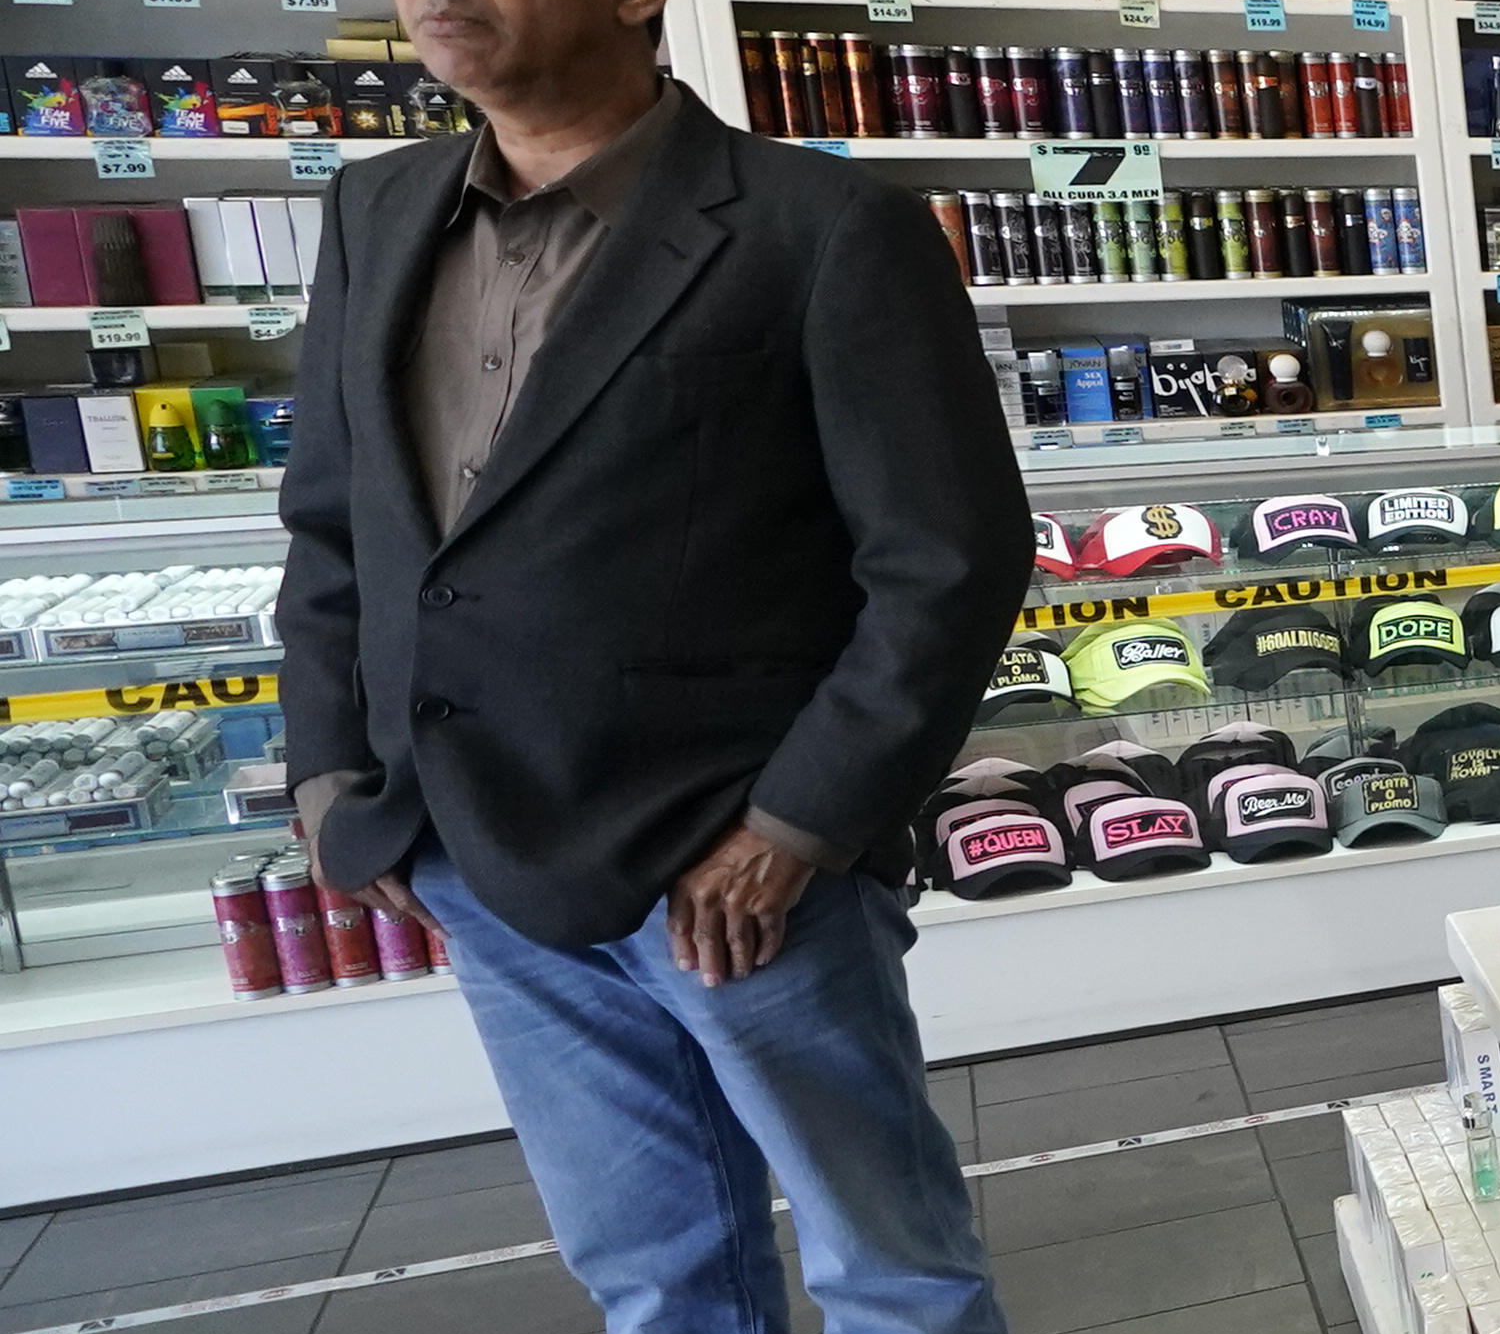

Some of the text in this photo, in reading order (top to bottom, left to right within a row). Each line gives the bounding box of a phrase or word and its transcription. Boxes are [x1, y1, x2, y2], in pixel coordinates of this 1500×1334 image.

[870, 7, 908, 19] $14.99
[37, 107, 71, 122] TEAM
[175, 109, 208, 123] TEAM
[40, 116, 69, 131] FIVE
[175, 118, 205, 132] FIVE
[102, 162, 147, 175] $7.99
[295, 164, 337, 176] $6.99
[1052, 146, 1126, 185] 7
[1042, 188, 1160, 201] ALL CUBA 3.4 MEN
[97, 331, 142, 345] $19.99
[1384, 496, 1448, 511] LIMITED
[1273, 509, 1338, 531] CRAY
[1384, 508, 1448, 523] EDITION
[1214, 568, 1448, 608] CAUTION
[1021, 596, 1150, 629] TION
[1380, 619, 1452, 642] DOPE
[1120, 641, 1185, 664] Baller
[997, 673, 1041, 685] PLOMO
[1371, 777, 1409, 790] PLATA
[1369, 798, 1412, 811] PLOMO
[1105, 814, 1188, 843] SLAY
[967, 828, 1045, 858] #QUEEN
